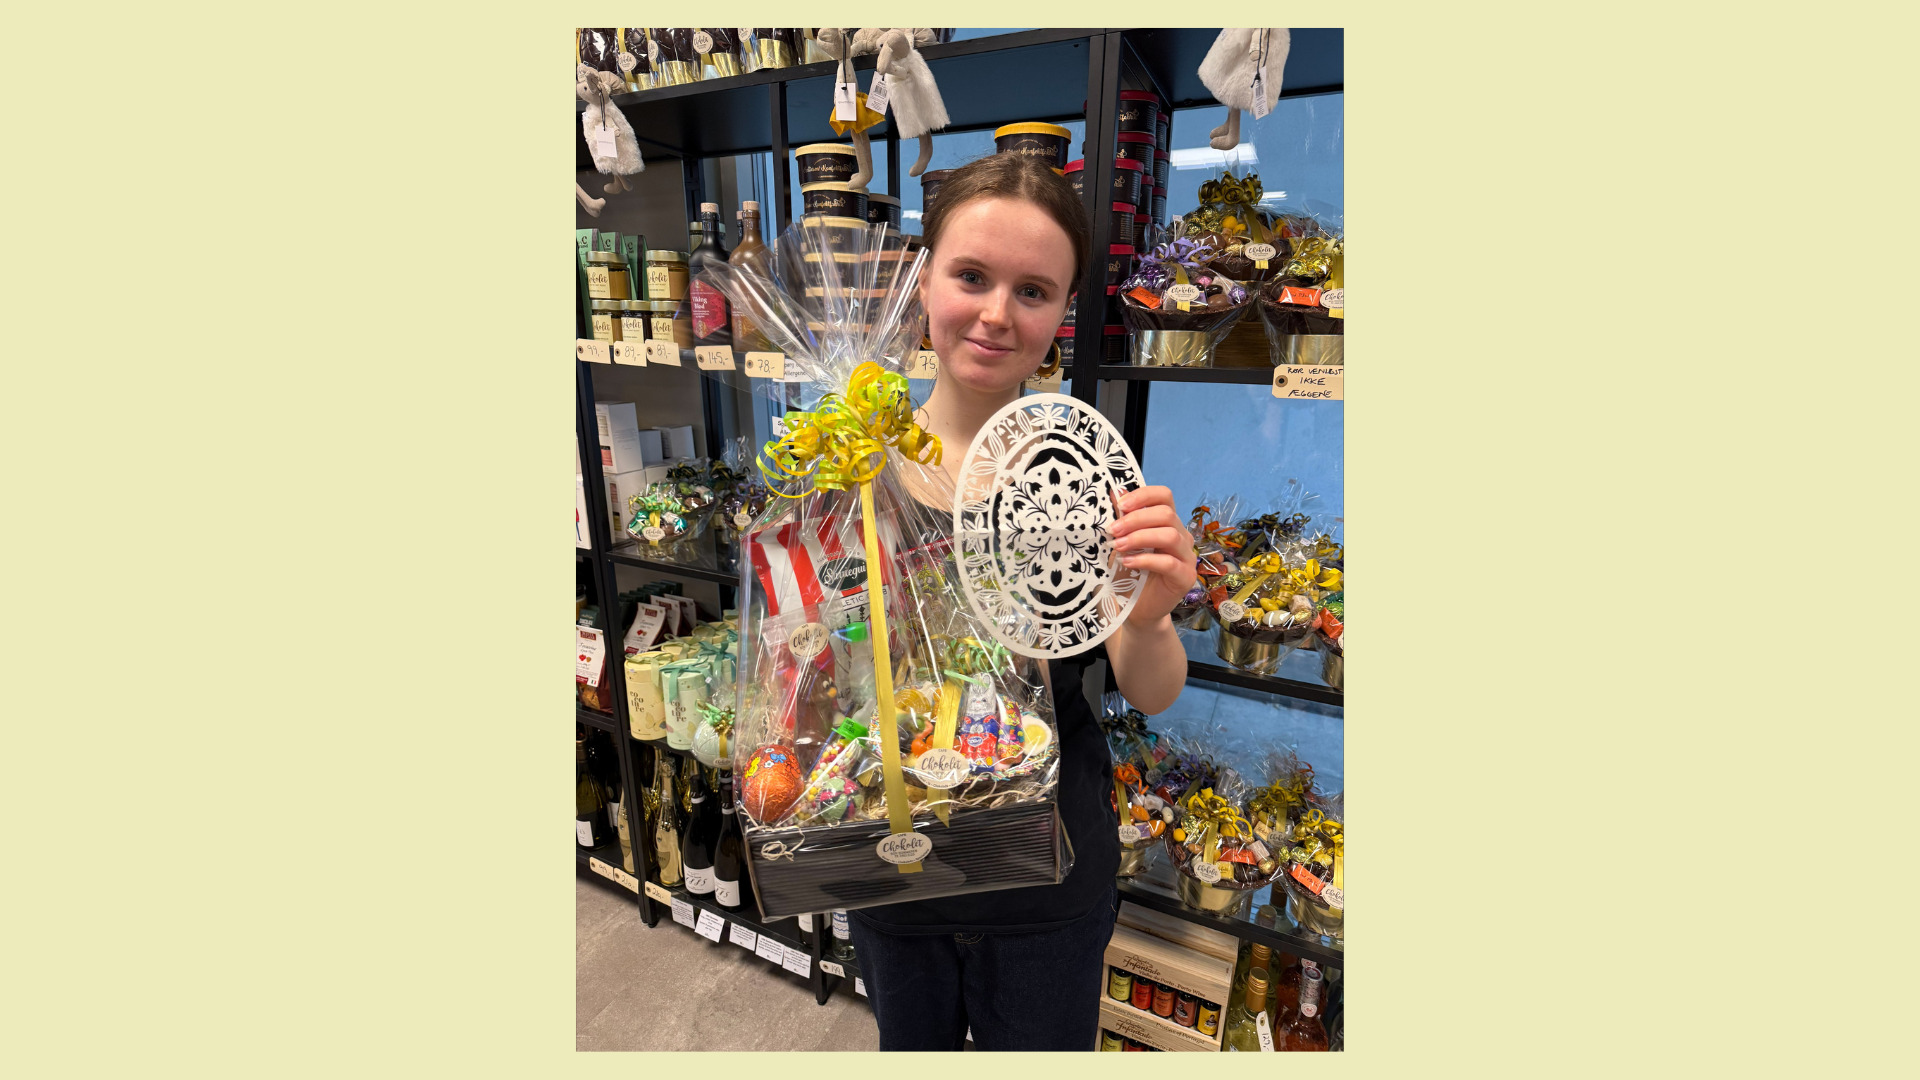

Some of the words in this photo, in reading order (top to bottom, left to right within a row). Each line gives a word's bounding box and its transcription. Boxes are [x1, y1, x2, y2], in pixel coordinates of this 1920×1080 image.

[1300, 377, 1326, 386] IKKE
[1287, 389, 1333, 399] ÆGGENE
[921, 754, 962, 771] Chokolet
[882, 837, 924, 853] Chokolet
